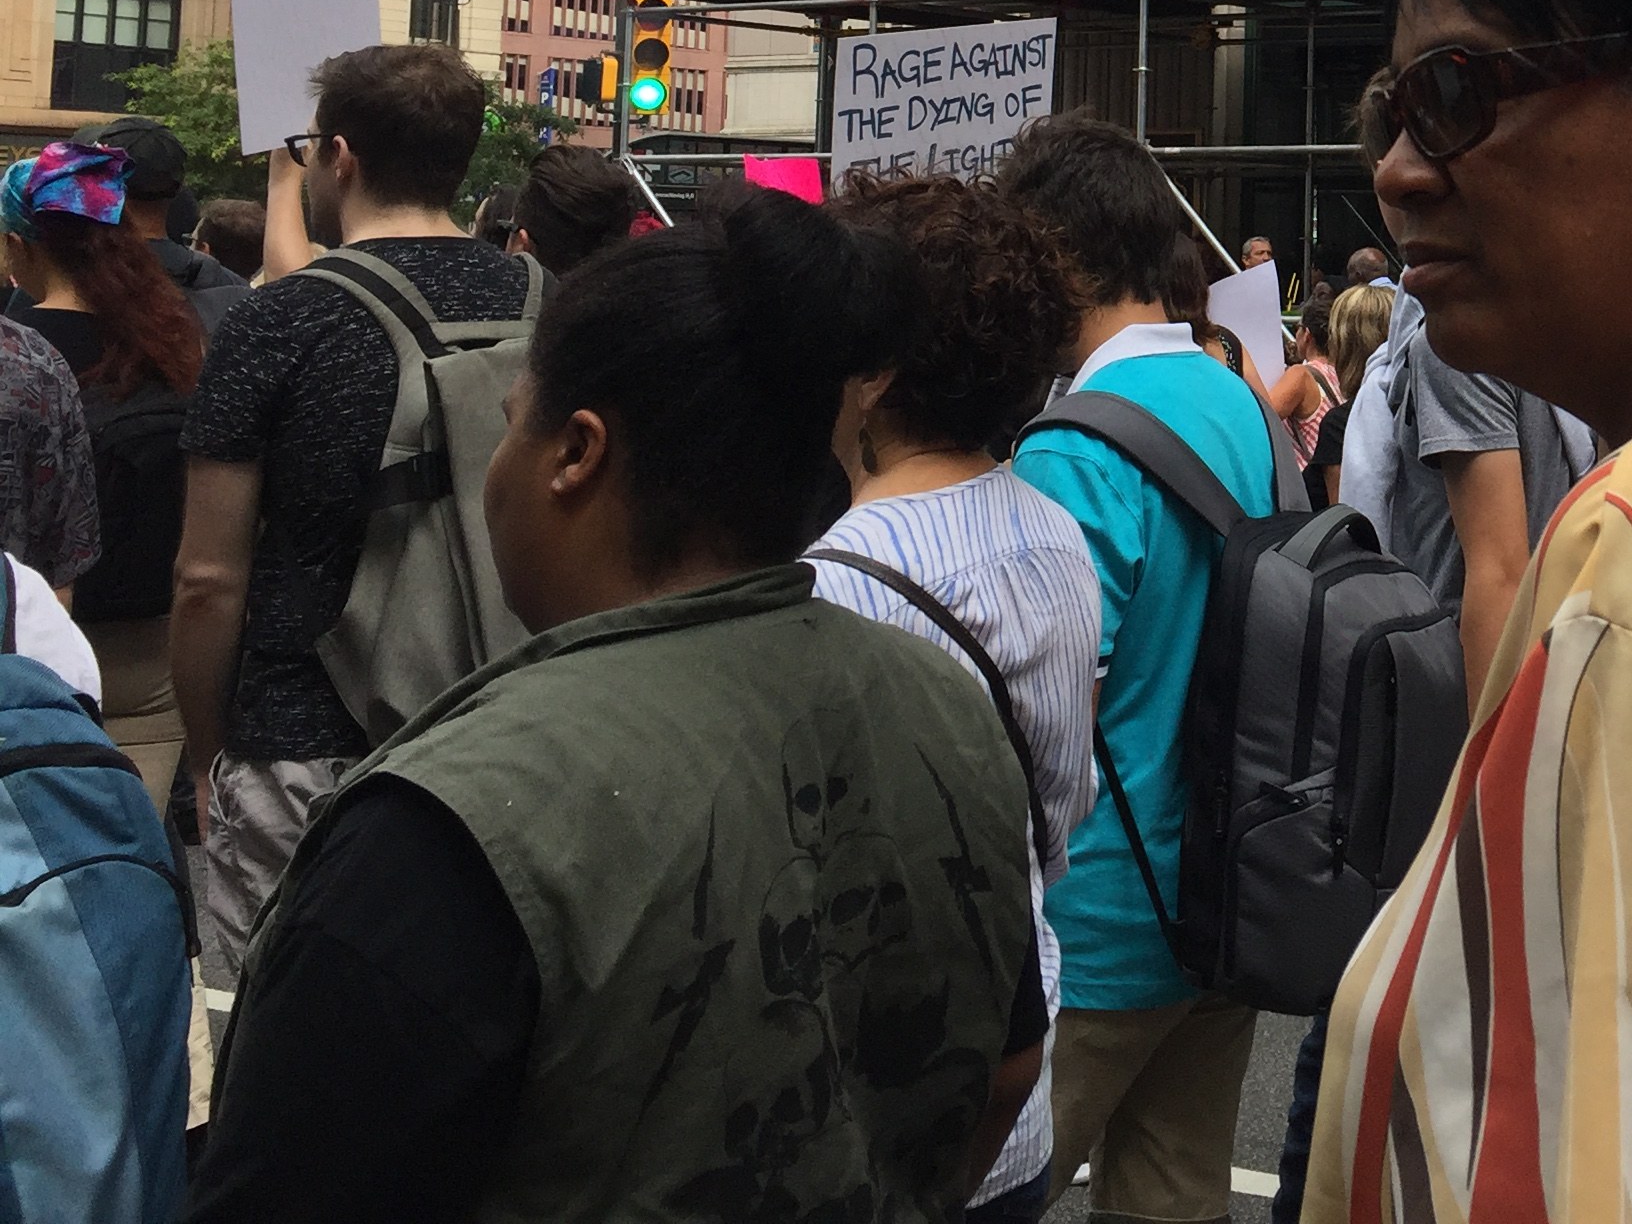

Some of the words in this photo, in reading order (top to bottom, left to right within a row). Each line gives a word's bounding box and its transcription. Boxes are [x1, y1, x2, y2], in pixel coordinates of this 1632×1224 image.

[852, 42, 946, 100] RAGE
[949, 33, 1054, 81] AGAINST
[838, 105, 900, 143] THE
[907, 92, 995, 132] DYING
[1004, 84, 1043, 119] OF
